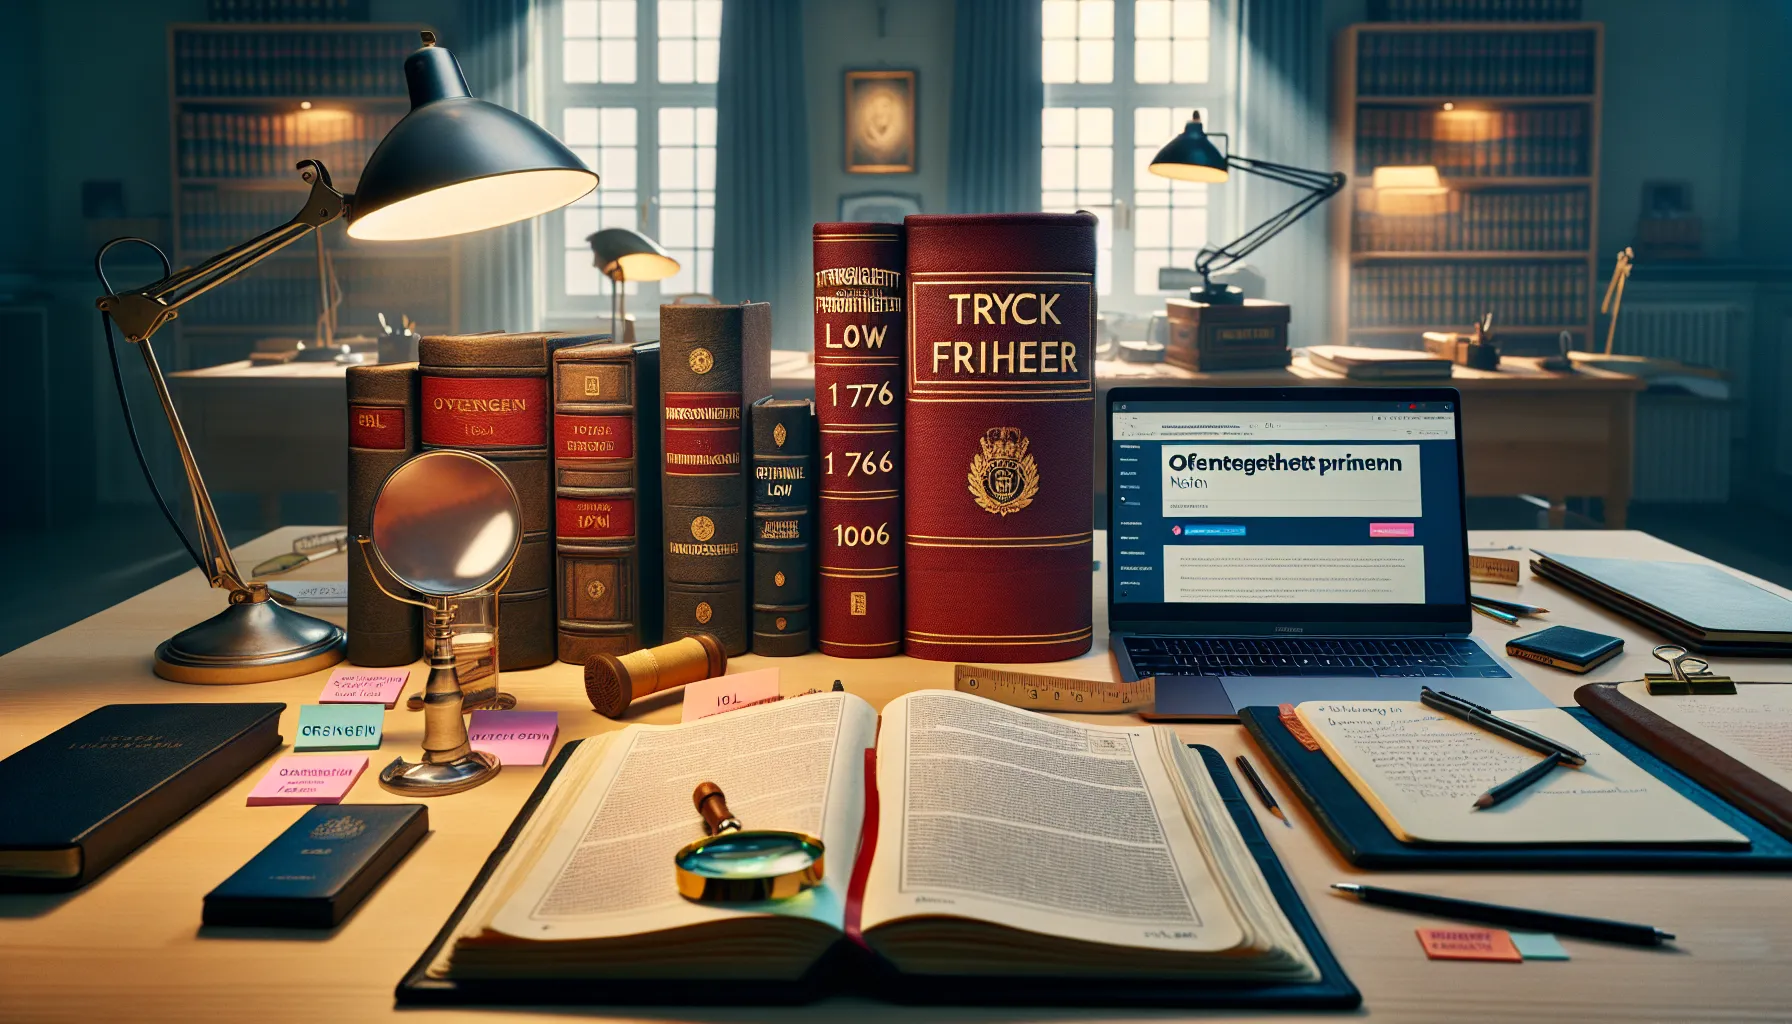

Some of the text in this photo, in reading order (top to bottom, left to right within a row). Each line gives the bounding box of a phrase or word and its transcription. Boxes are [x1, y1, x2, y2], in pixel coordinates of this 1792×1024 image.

[948, 293, 1062, 325] TRYCK
[825, 323, 888, 349] LOW
[932, 341, 1078, 374] FRIHEER
[833, 522, 890, 547] 1006
